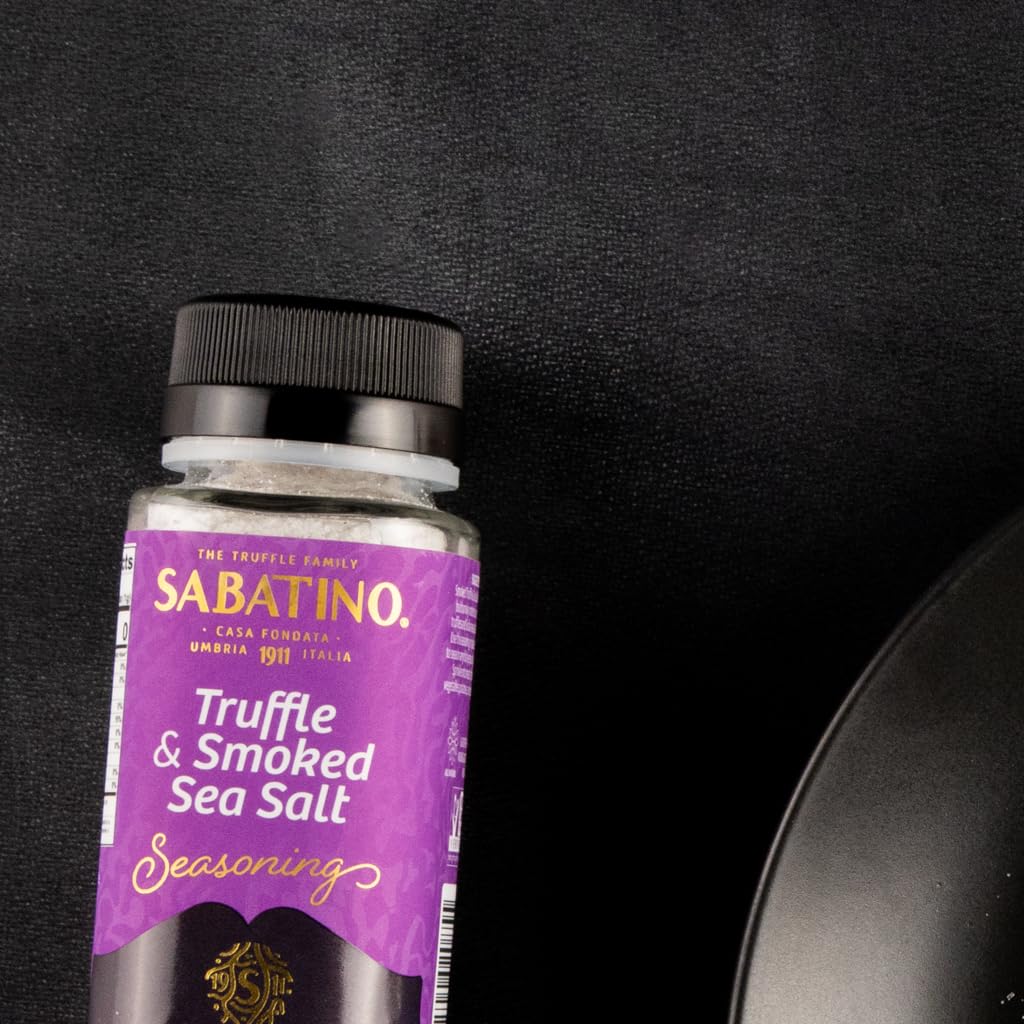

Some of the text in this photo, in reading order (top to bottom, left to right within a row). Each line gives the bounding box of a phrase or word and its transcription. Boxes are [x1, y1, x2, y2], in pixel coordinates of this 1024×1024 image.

[198, 549, 359, 570] THE TRUFFLE FAMILY
[190, 641, 351, 666] UMBRIA 1911 ITALIA
[216, 626, 329, 642] CASA FONDATA
[195, 688, 337, 741] Truffle
[153, 730, 375, 781] & Smoked
[167, 775, 247, 817] Sea
[256, 781, 351, 824] Salt
[132, 833, 381, 906] Seasoning
